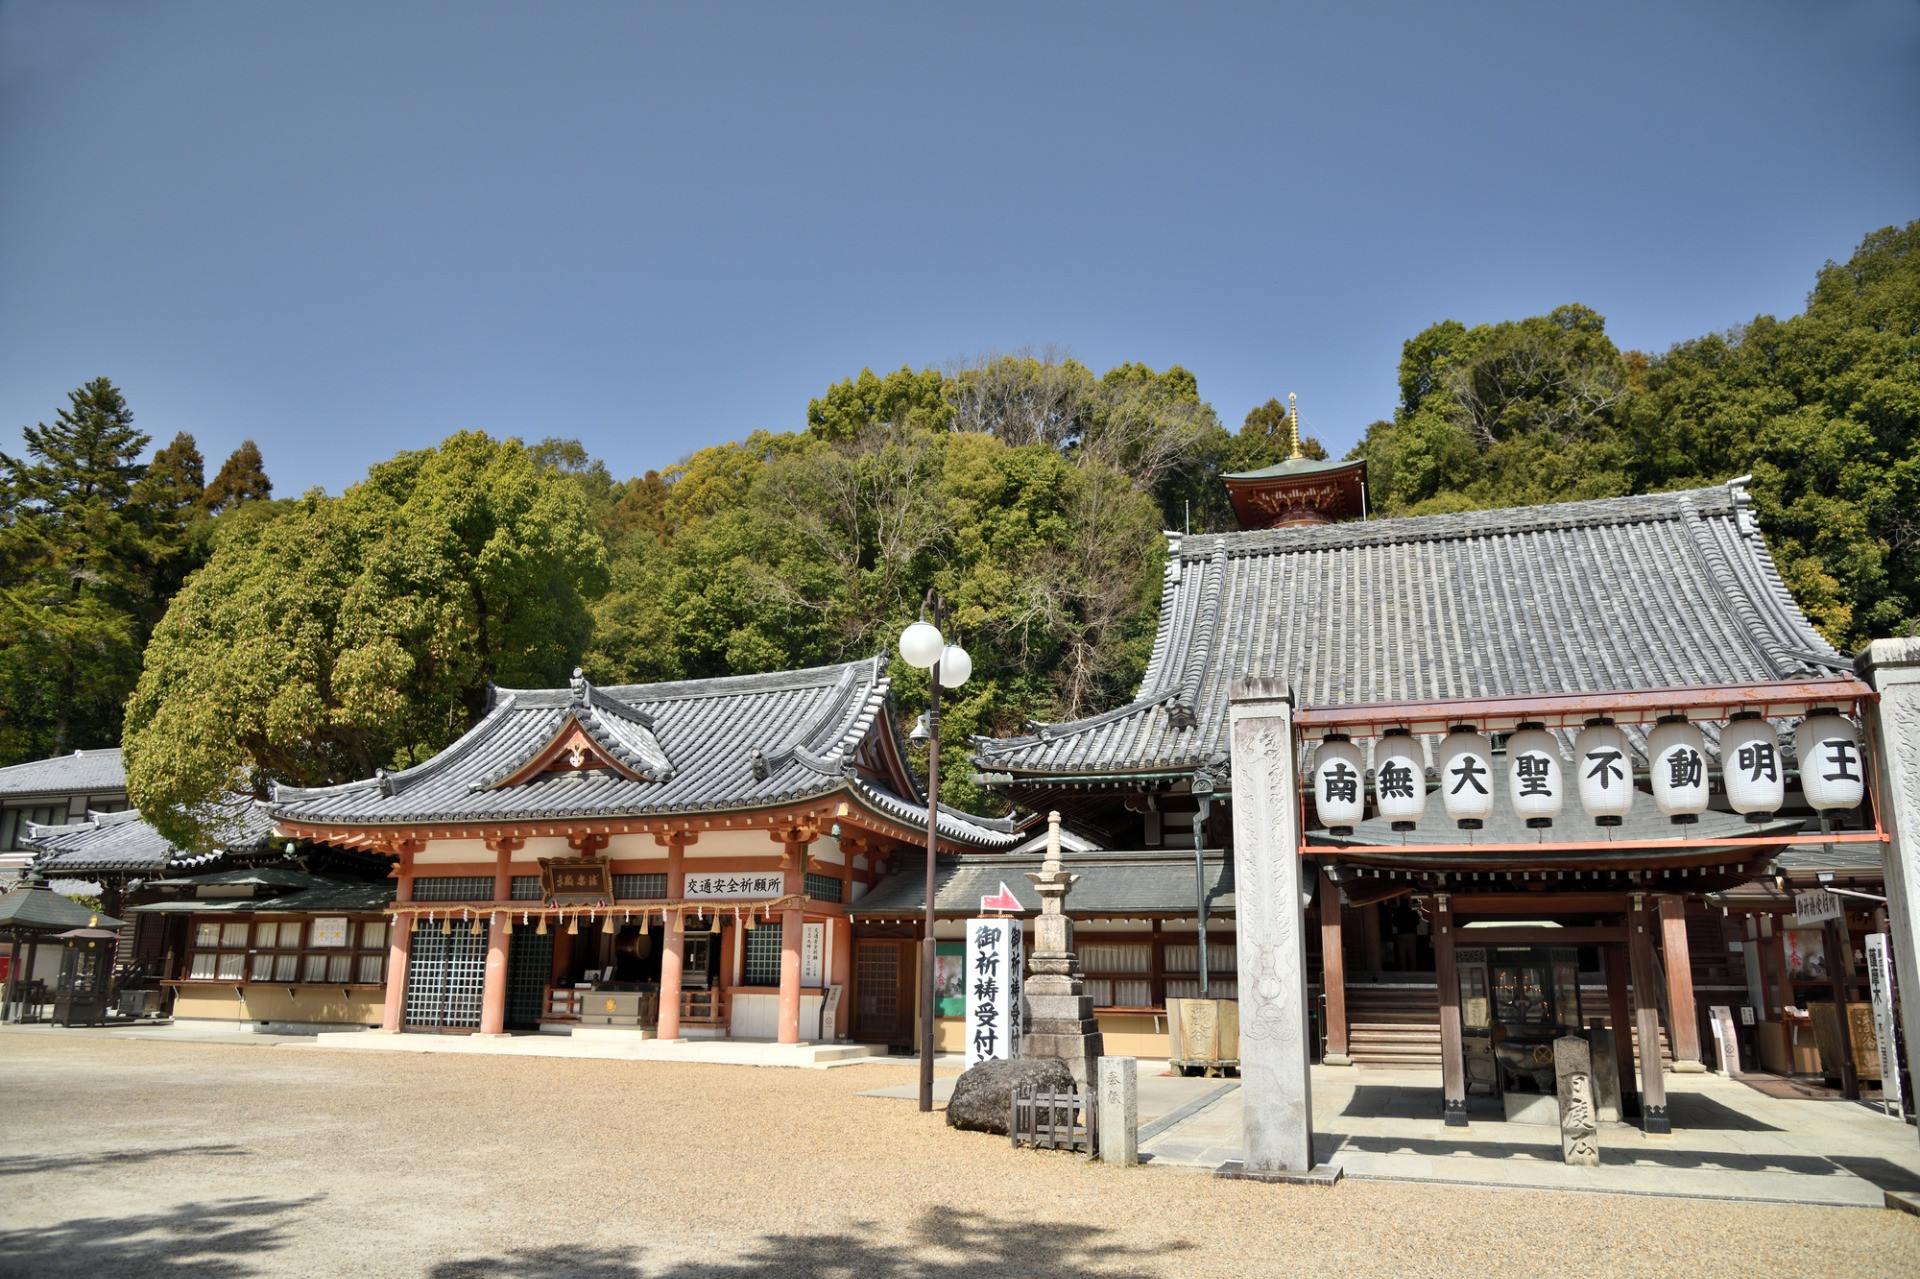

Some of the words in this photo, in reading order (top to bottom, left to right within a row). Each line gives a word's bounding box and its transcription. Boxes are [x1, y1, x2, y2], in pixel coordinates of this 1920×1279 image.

[1323, 739, 1861, 804] 南無大聖不動明王
[687, 877, 781, 894] 交通安全祈願所
[1010, 926, 1021, 1060] 御祈祷受付
